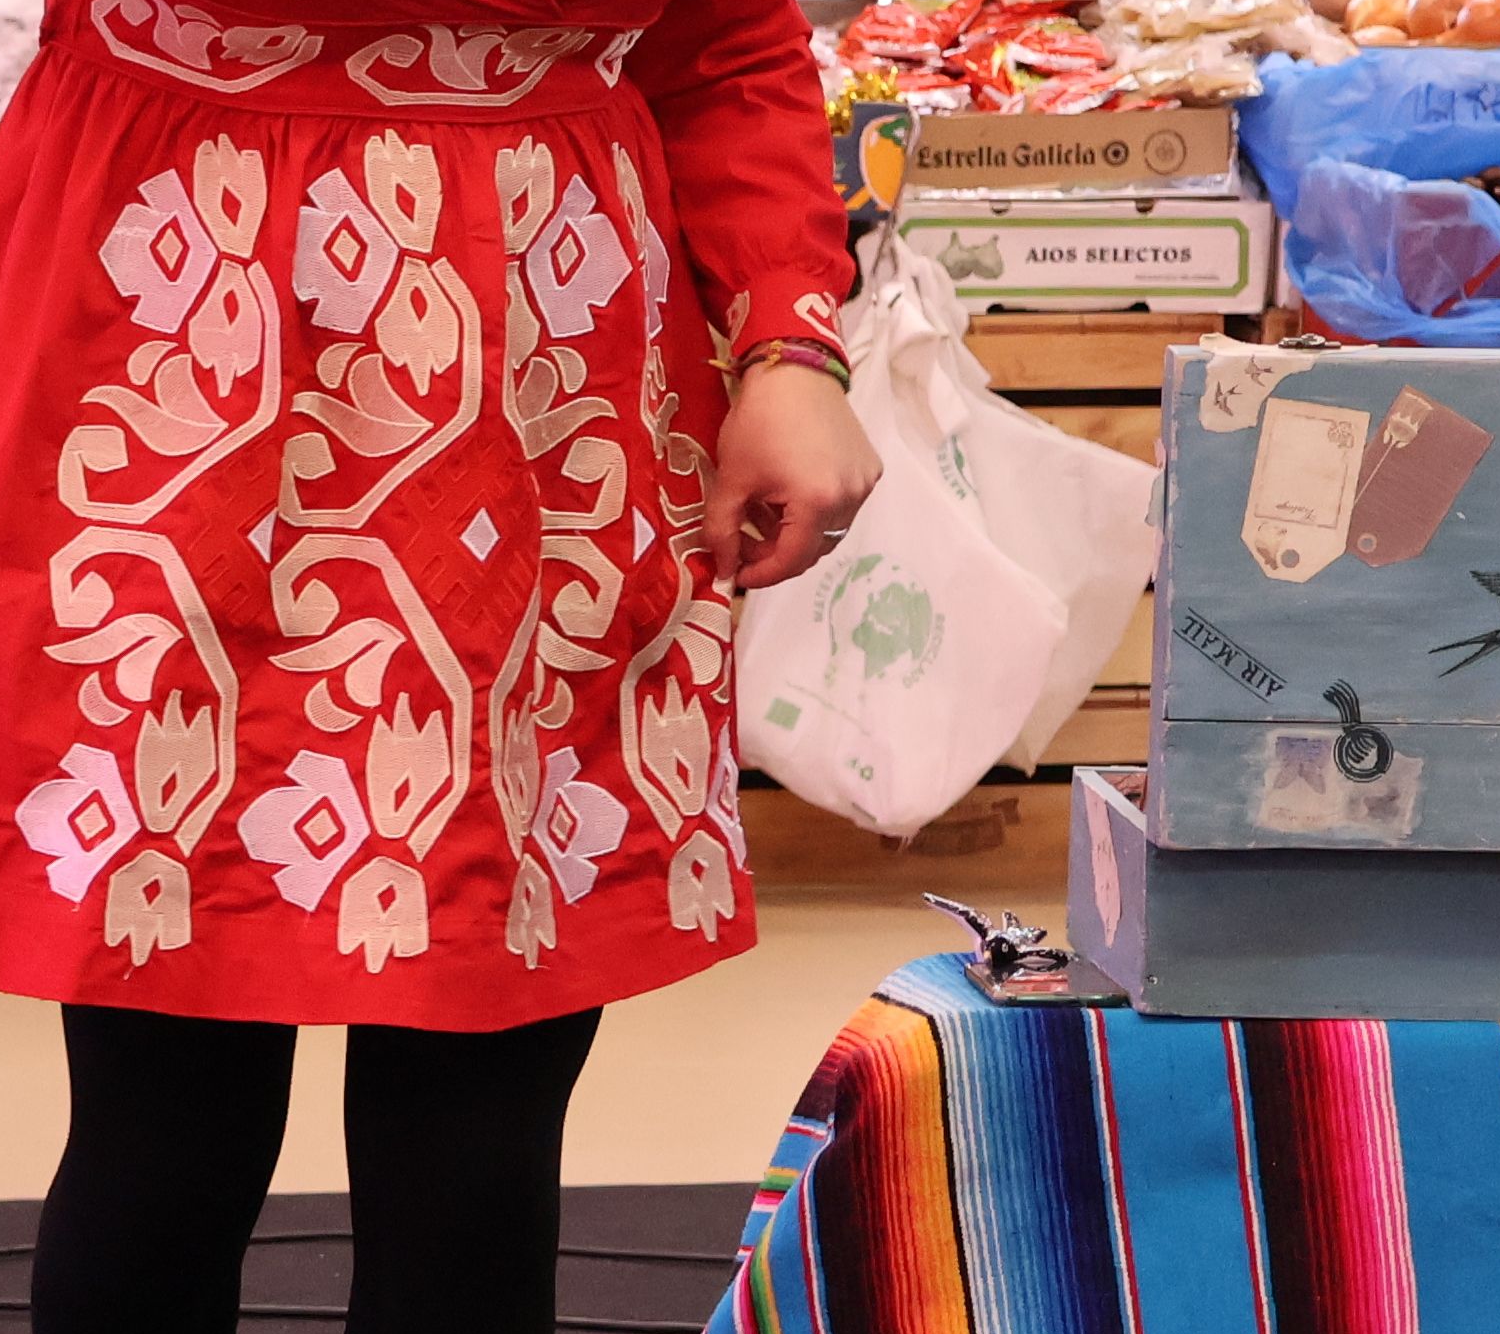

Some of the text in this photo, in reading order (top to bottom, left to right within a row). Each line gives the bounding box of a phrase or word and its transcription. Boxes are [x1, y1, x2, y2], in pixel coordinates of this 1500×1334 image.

[916, 141, 1096, 171] Estrella Galicia
[1024, 245, 1194, 266] AJOS SELECTOS
[1179, 615, 1286, 698] AIR MAIL
